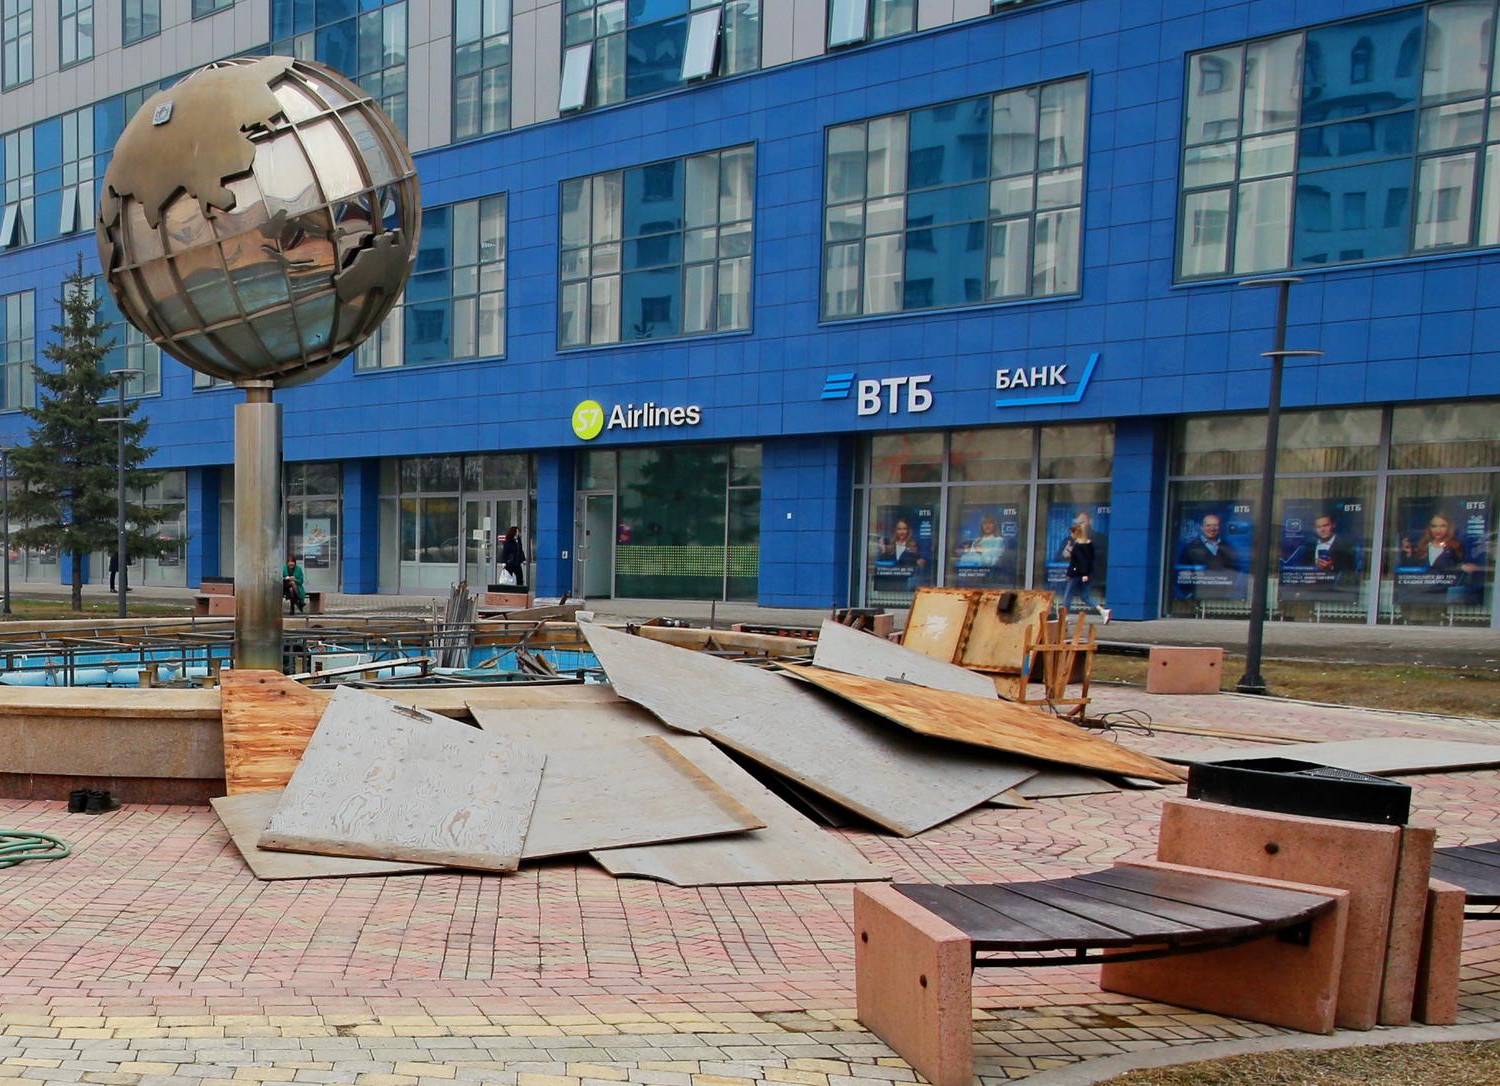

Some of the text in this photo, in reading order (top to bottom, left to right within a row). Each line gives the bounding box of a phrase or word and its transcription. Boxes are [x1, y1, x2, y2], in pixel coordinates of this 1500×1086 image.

[996, 364, 1068, 390] БАНК
[858, 374, 933, 416] ВТБ
[577, 402, 700, 432] S7 Airlines
[1344, 503, 1362, 512] ВТБ
[1466, 501, 1485, 510] ВТБ
